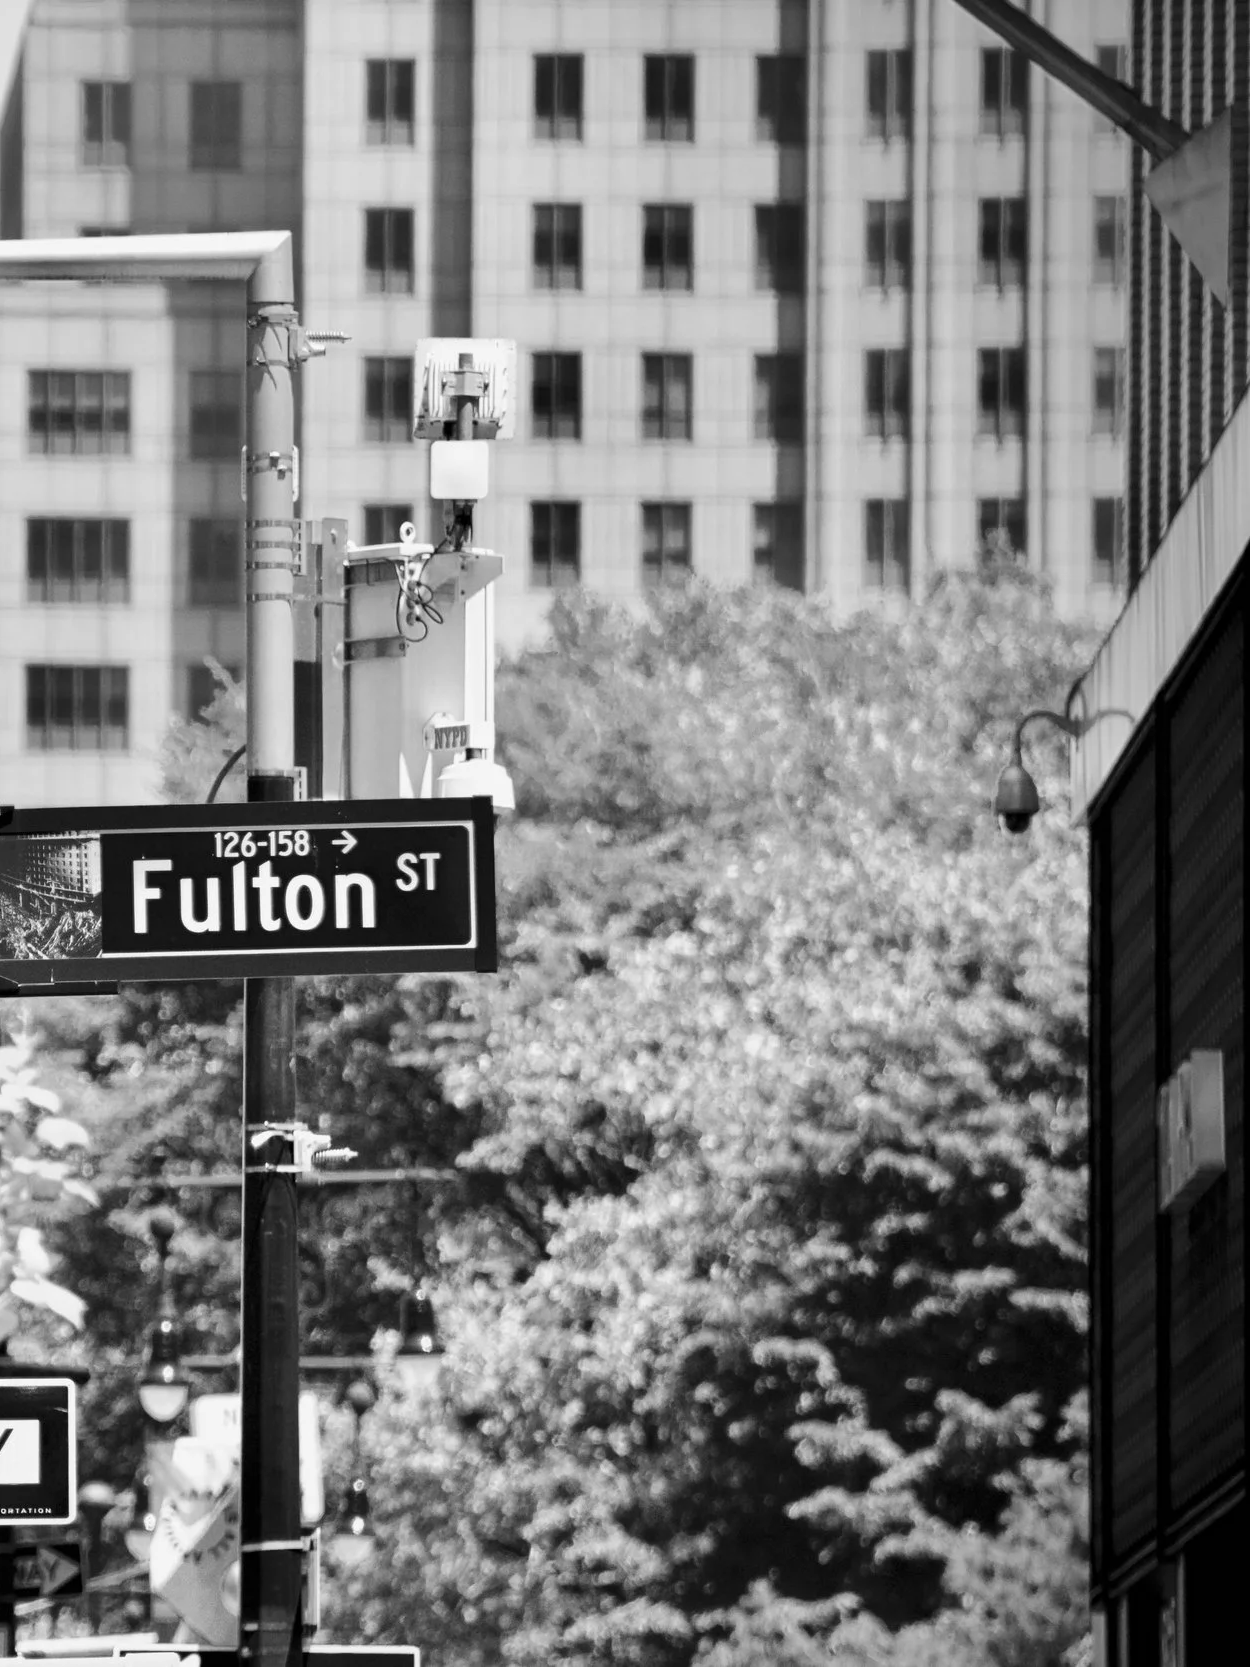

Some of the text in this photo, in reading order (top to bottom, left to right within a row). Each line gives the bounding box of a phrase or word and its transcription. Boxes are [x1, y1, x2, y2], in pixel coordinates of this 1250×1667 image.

[434, 725, 467, 750] NYPD
[214, 830, 310, 858] 126-158
[133, 852, 441, 934] Fulton ST
